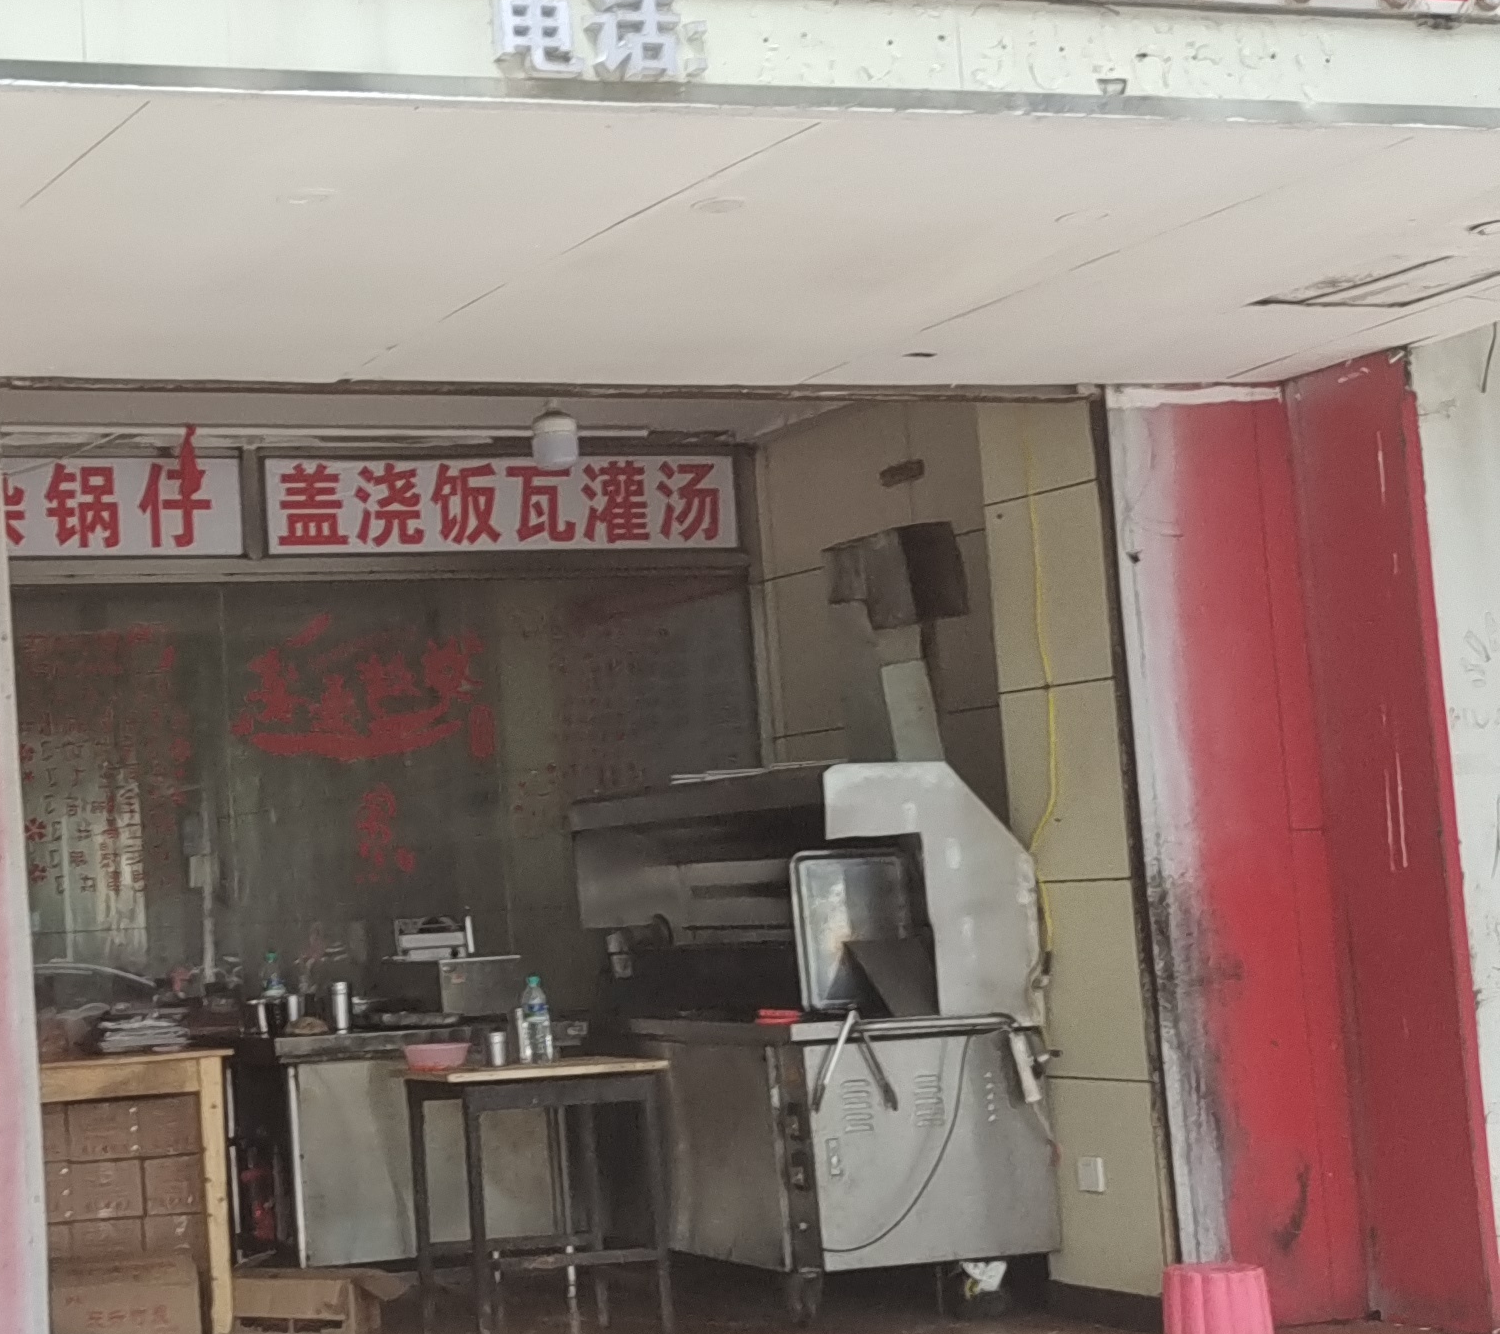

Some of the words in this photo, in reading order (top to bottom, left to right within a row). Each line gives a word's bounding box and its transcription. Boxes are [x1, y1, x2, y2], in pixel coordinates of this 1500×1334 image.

[278, 461, 721, 547] 盖浇饭瓦灌汤
